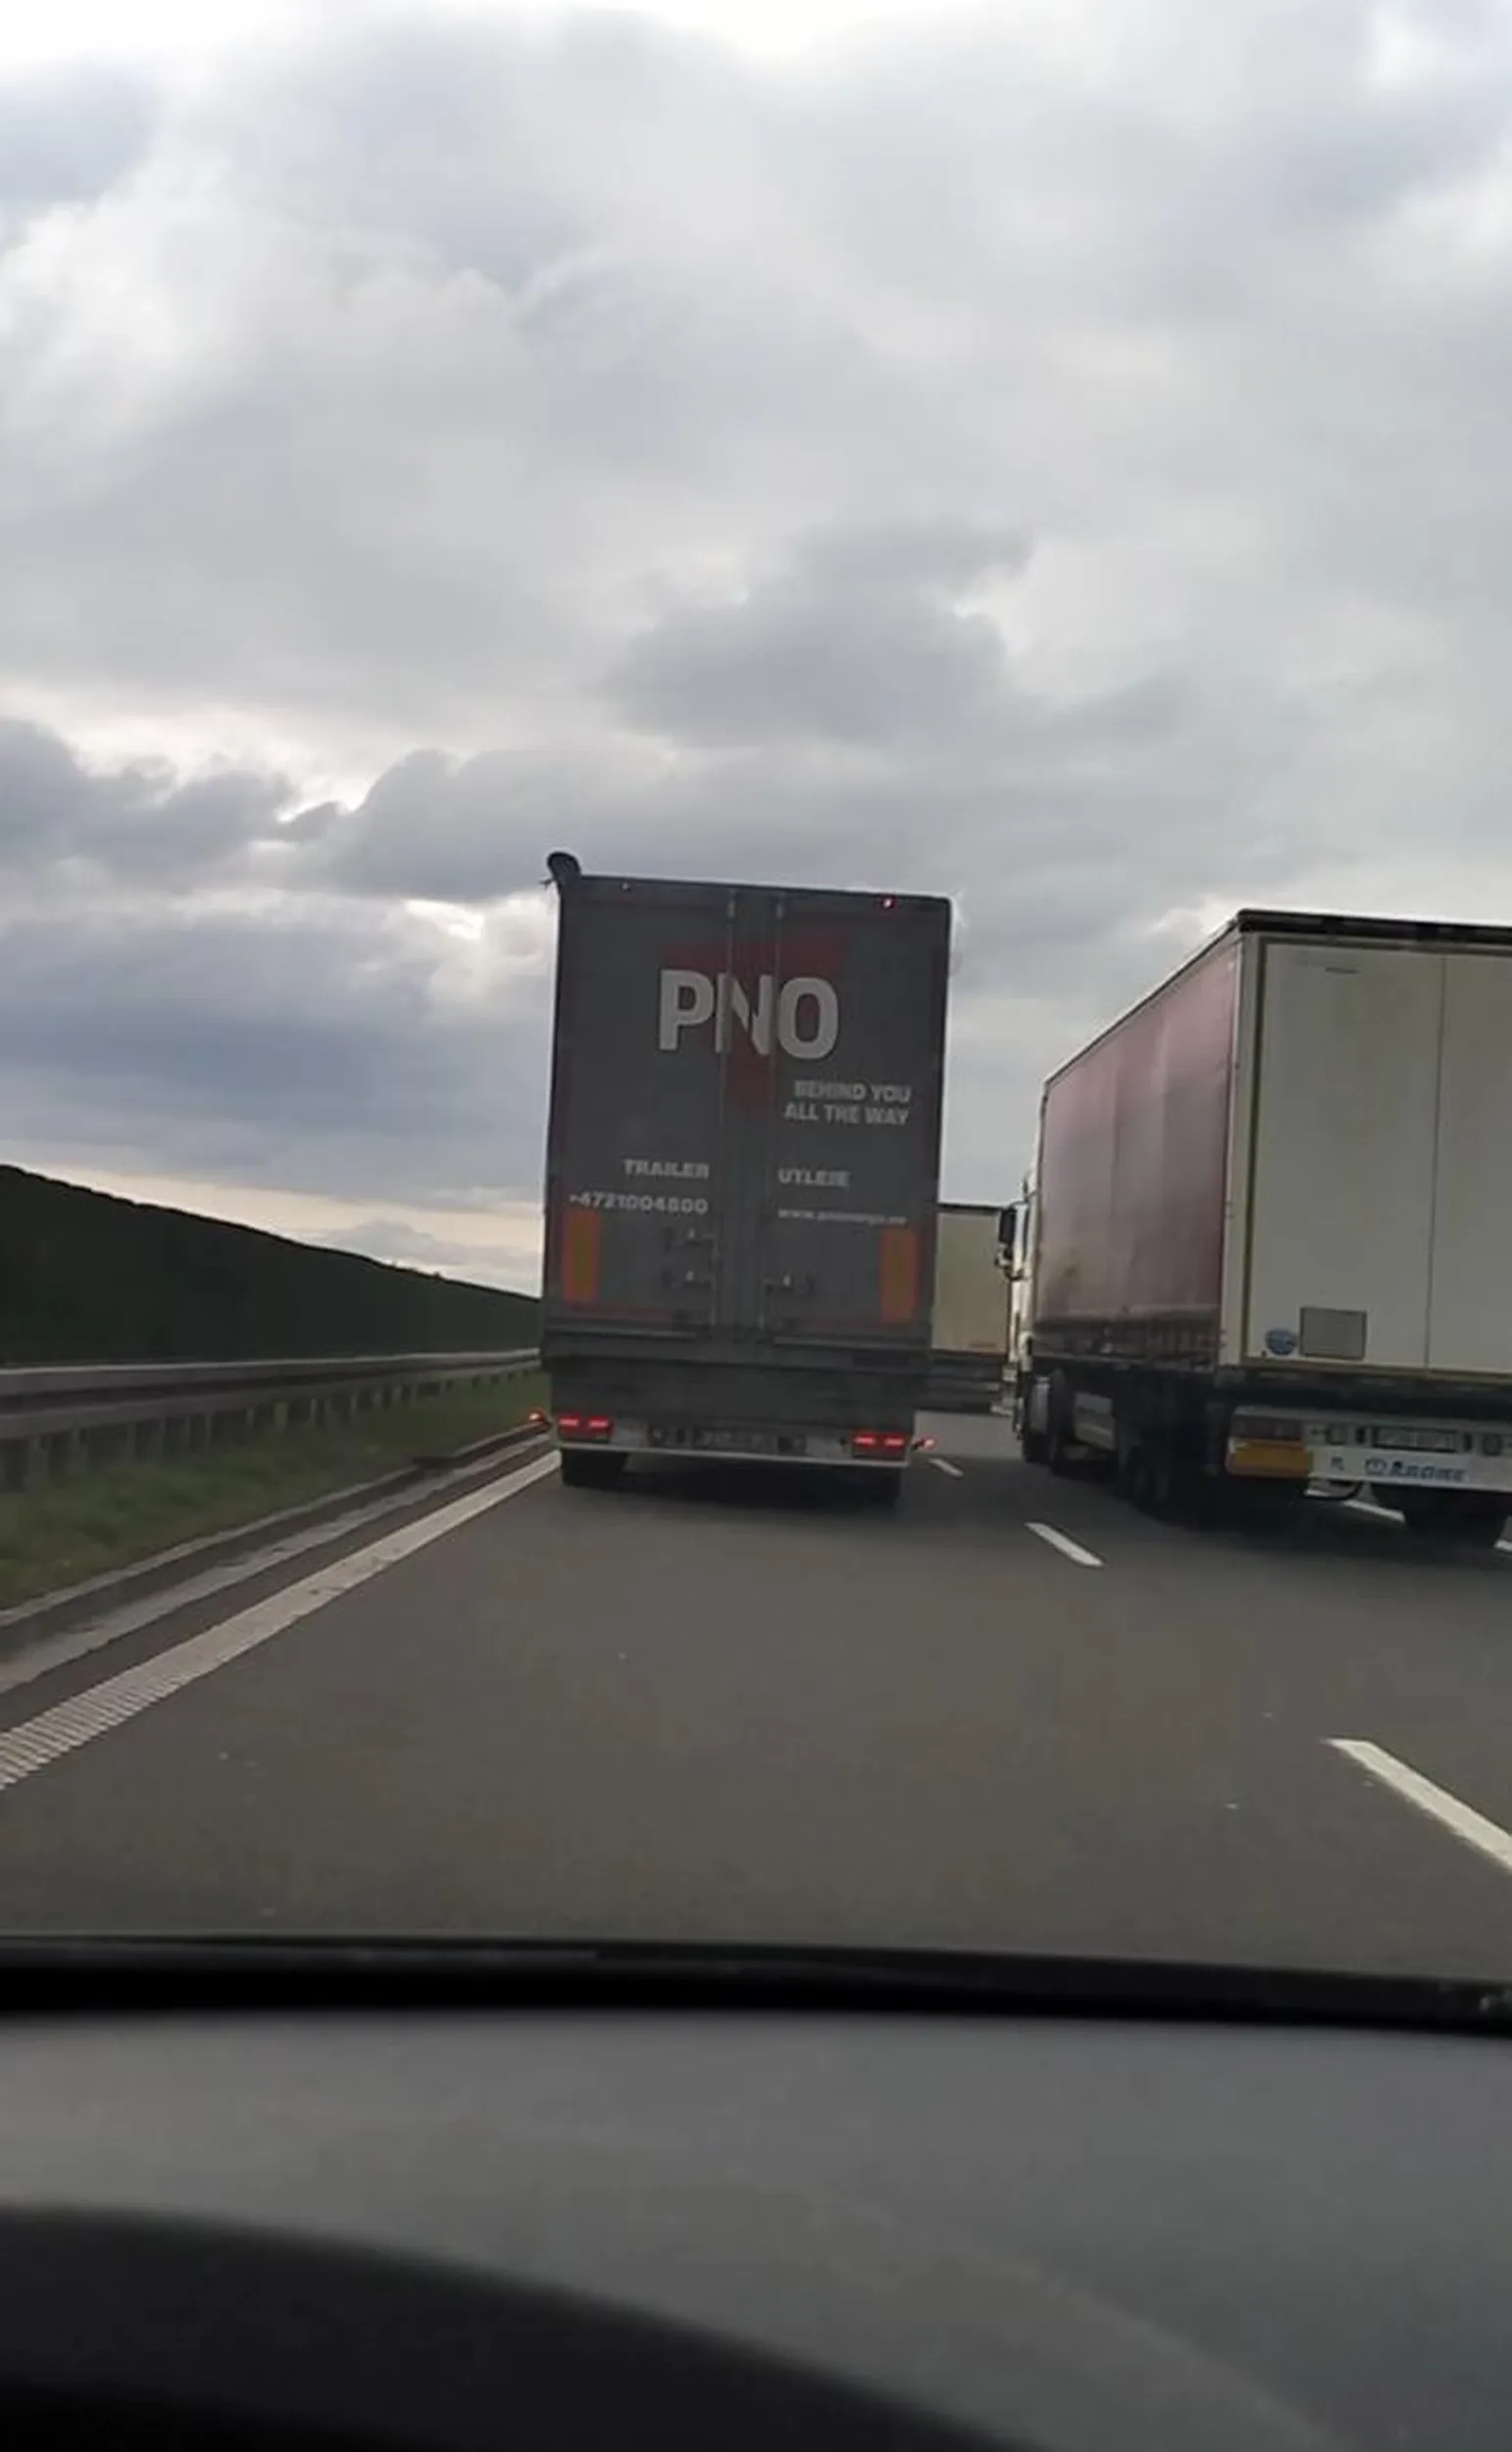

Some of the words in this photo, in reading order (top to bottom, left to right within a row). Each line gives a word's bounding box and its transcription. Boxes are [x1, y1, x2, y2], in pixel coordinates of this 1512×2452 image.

[659, 969, 839, 1059] PNO
[794, 1080, 867, 1102] BEHIND
[872, 1084, 912, 1104] YOU
[784, 1102, 820, 1121] ALL
[824, 1104, 860, 1124] THE
[865, 1107, 910, 1126] WAY
[625, 1158, 710, 1179] TRAILER
